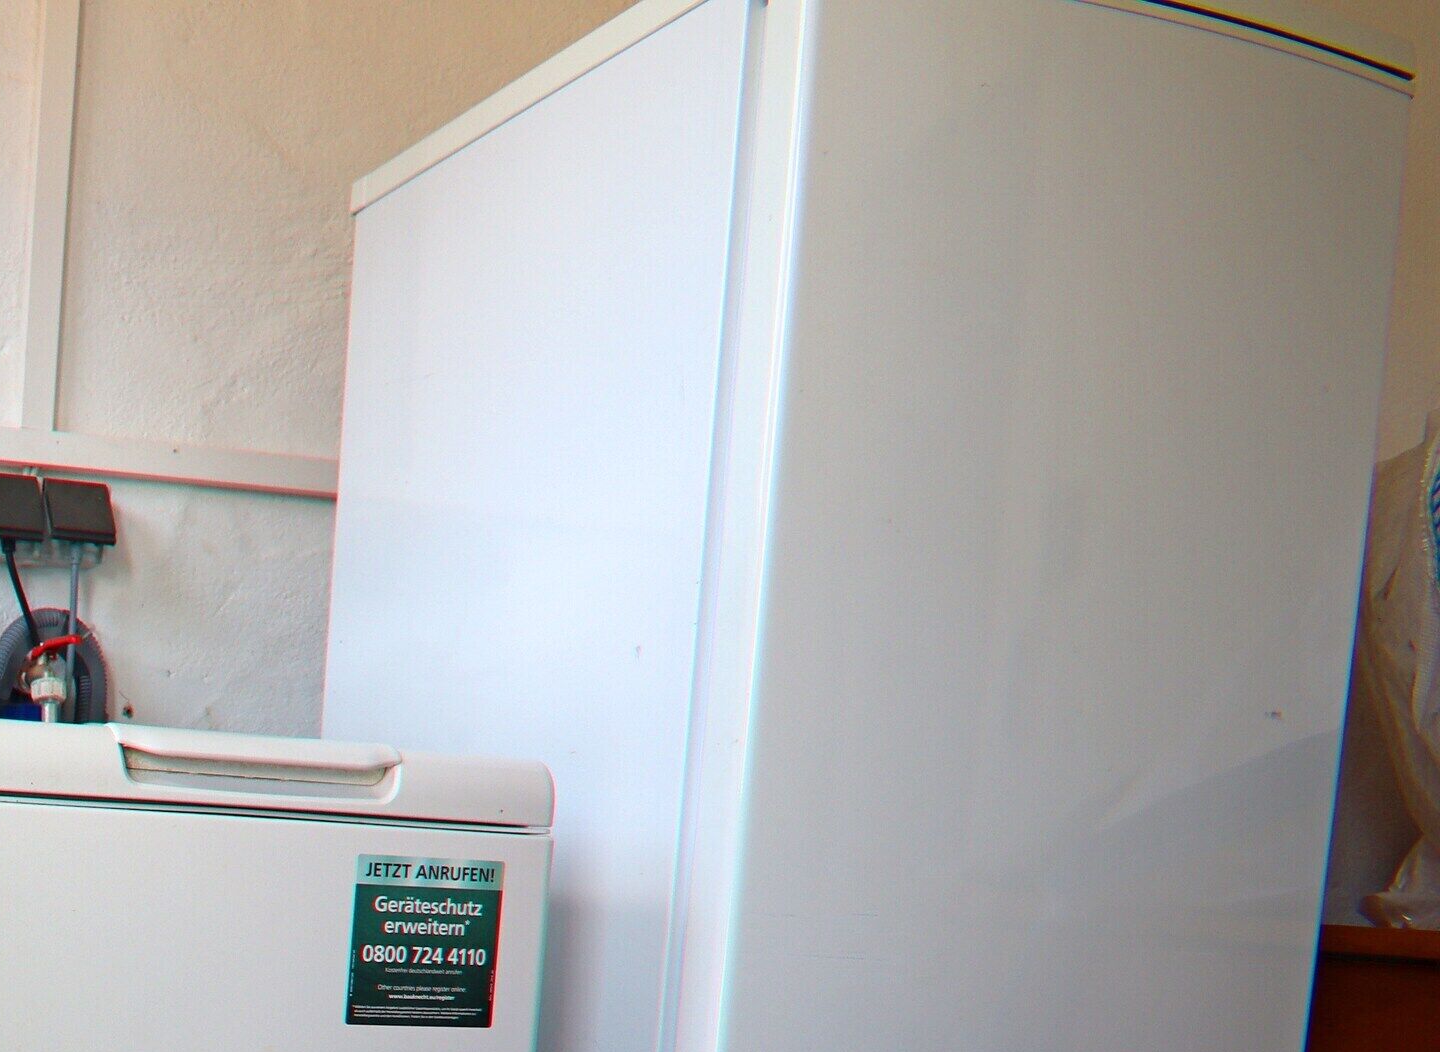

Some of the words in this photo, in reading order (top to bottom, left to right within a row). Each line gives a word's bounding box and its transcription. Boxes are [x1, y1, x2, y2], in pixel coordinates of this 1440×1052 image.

[366, 862, 412, 878] JETZT
[415, 865, 495, 883] ANRUFEN!
[374, 896, 483, 917] Geräteschutz
[363, 945, 407, 963] 0800
[412, 946, 443, 965] 724
[447, 948, 486, 966] 4110
[416, 985, 431, 993] please
